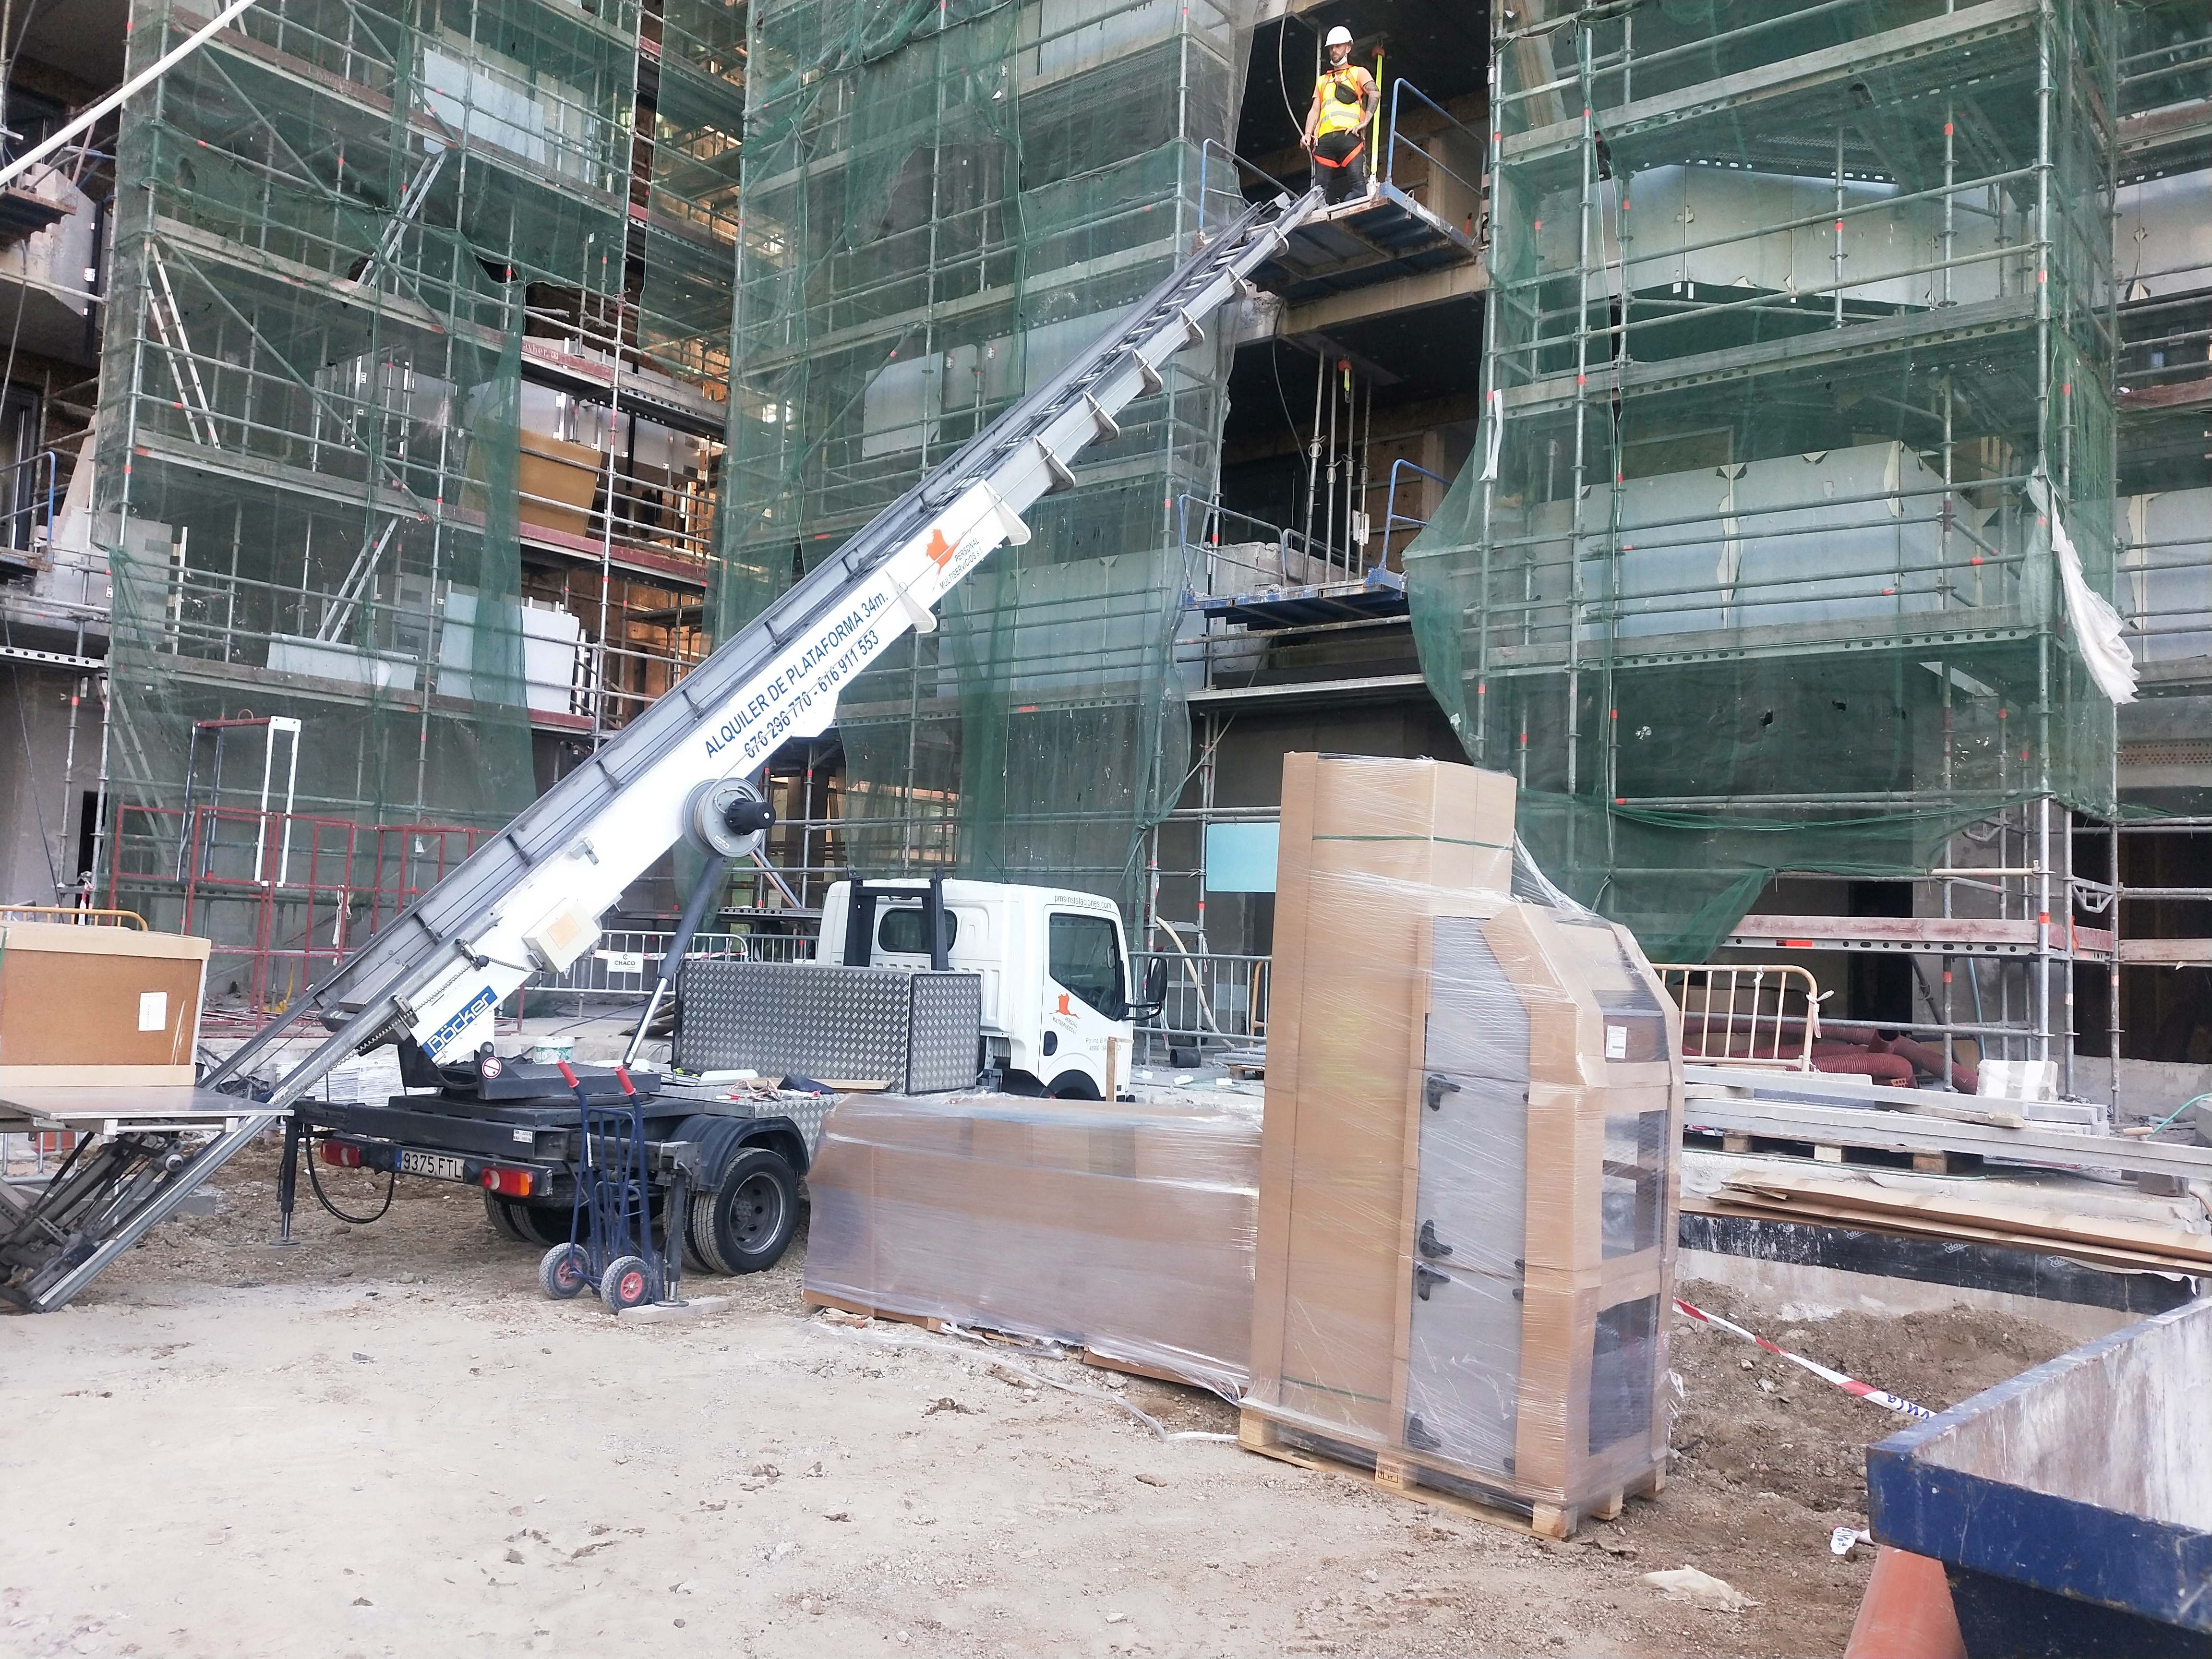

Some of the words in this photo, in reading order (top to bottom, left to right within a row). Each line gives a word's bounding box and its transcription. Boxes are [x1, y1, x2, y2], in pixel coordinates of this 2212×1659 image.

[939, 552, 976, 590] MULTISERVICIOS
[954, 538, 979, 562] PERSONAL
[705, 694, 770, 758] ALQUILER
[767, 677, 788, 701] DE
[786, 611, 864, 685] PLATAFORMA
[861, 593, 889, 618] 34m.
[744, 731, 768, 758] 676
[767, 711, 790, 739] 296
[788, 691, 812, 718] 770
[838, 648, 858, 673] 911
[858, 630, 878, 655] 553
[426, 992, 490, 1054] Böcker
[404, 1153, 434, 1173] 9375
[439, 1158, 462, 1178] FTL
